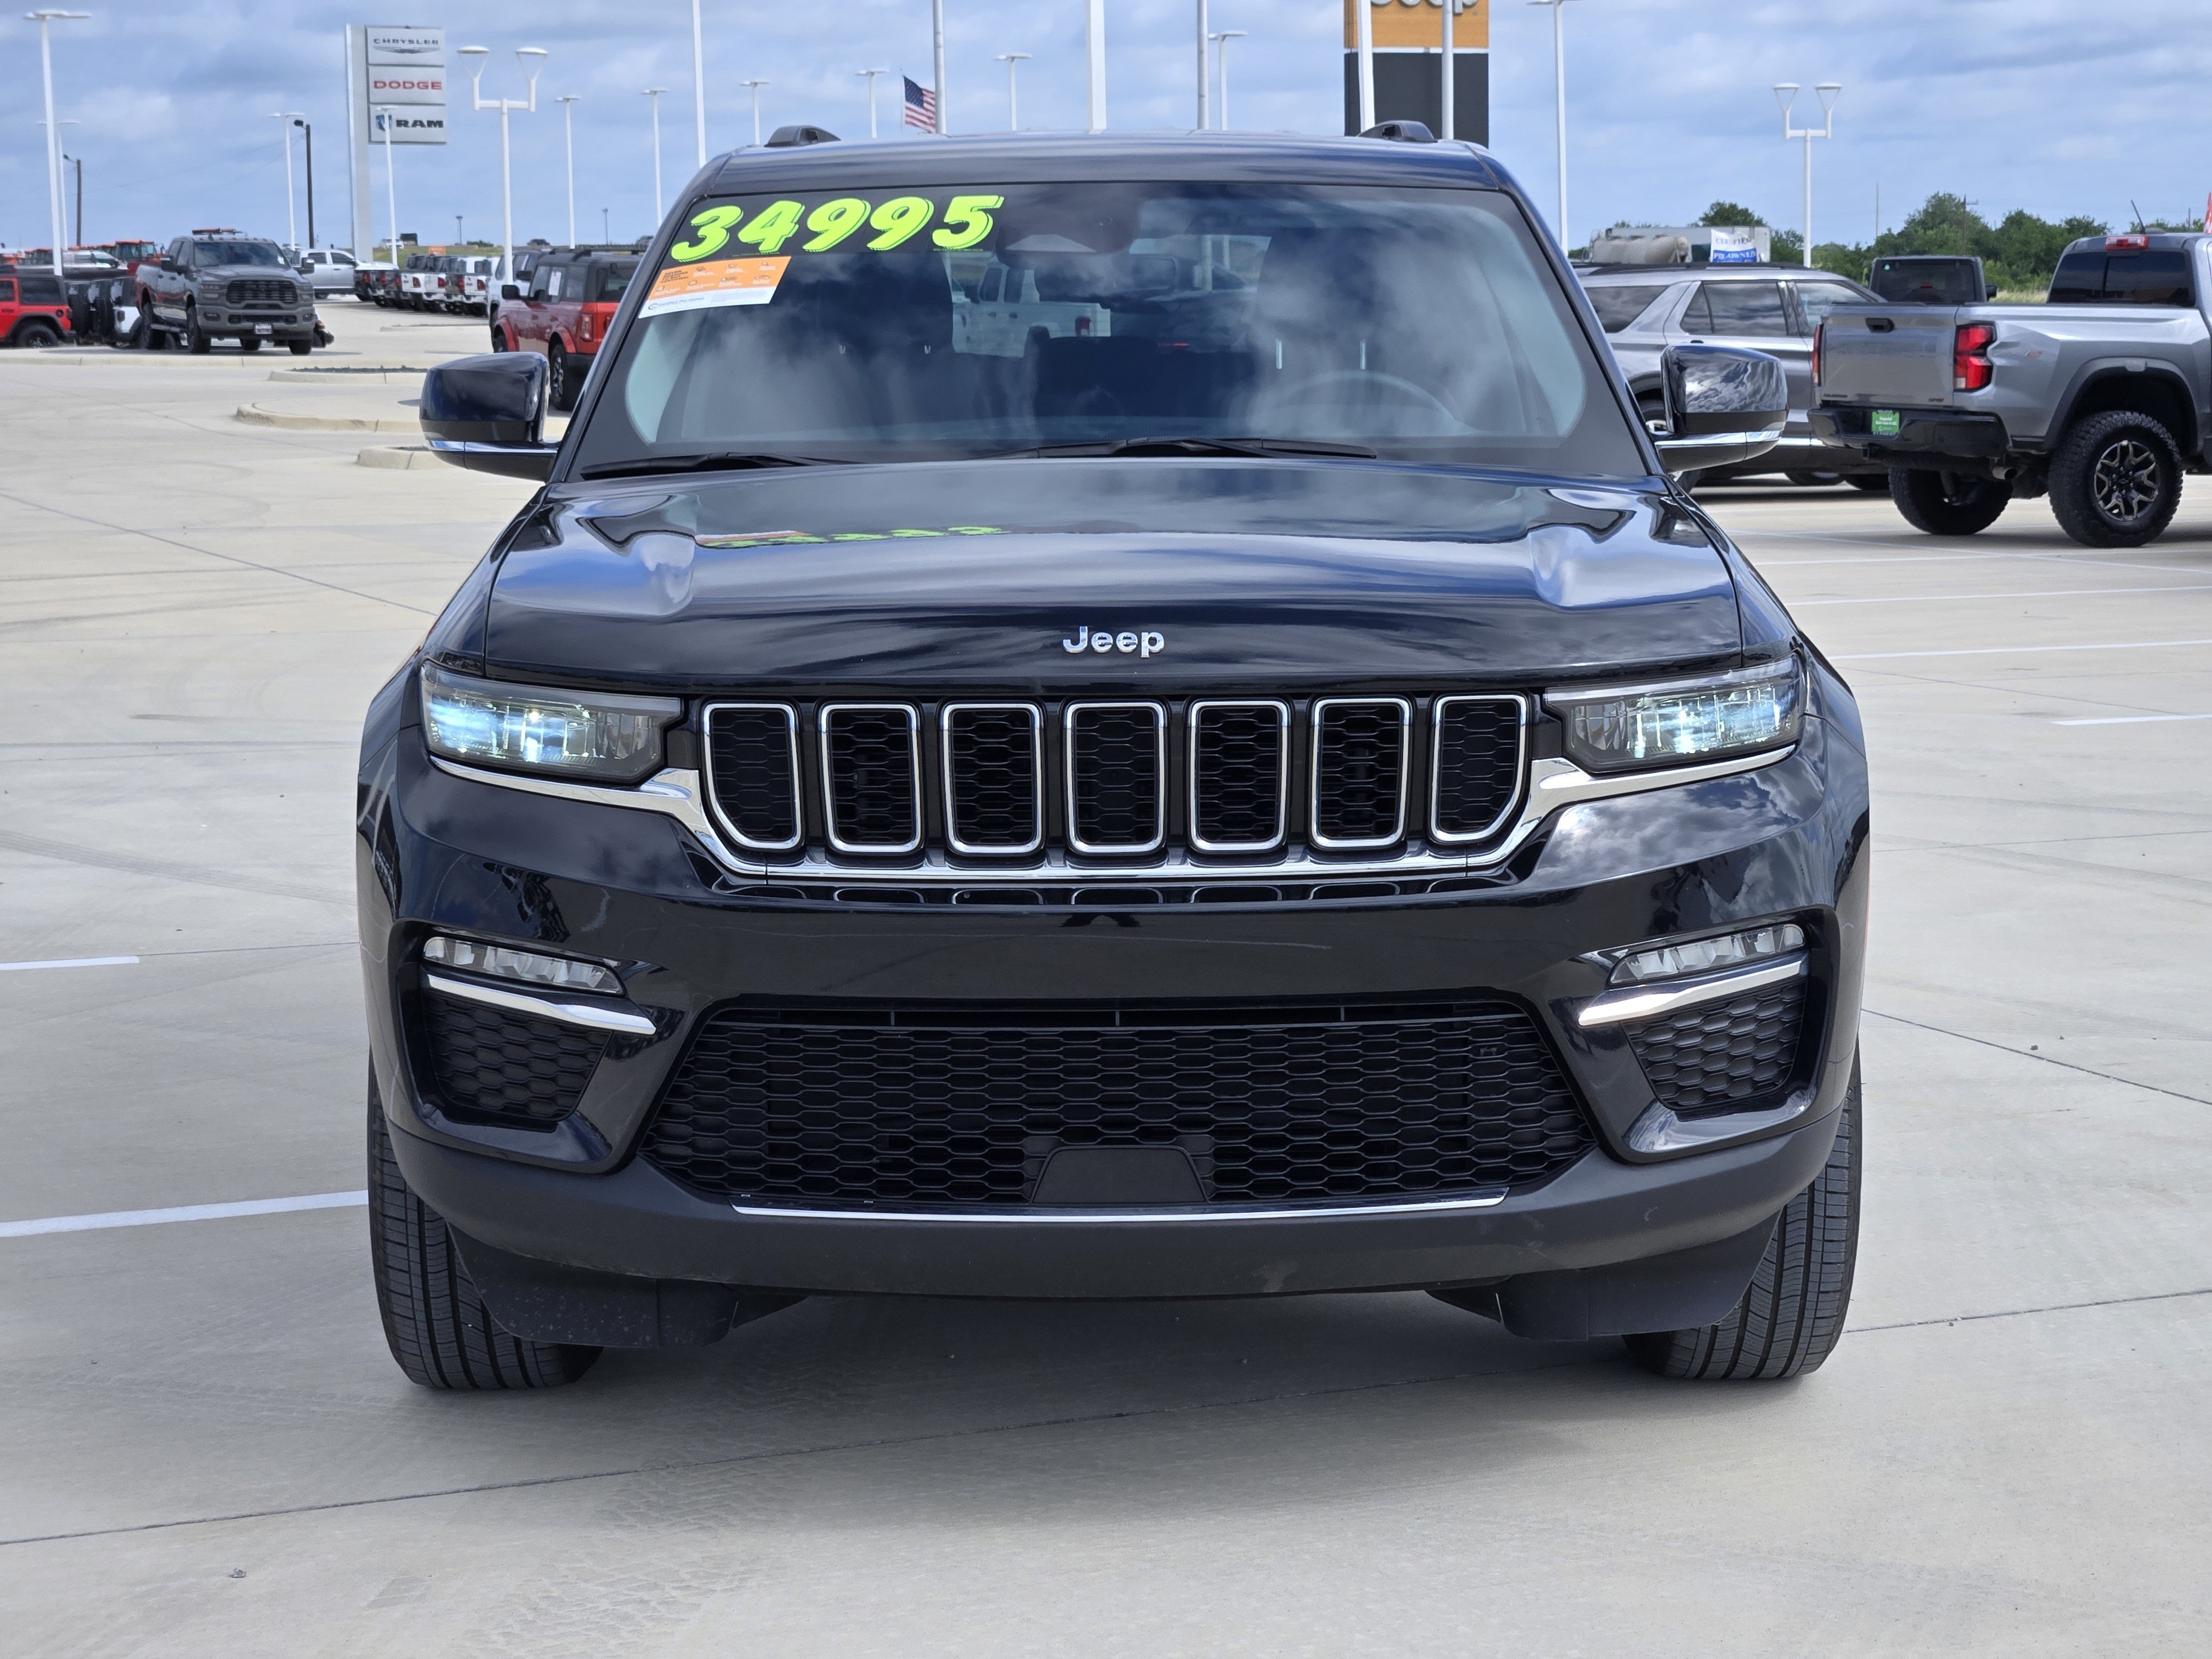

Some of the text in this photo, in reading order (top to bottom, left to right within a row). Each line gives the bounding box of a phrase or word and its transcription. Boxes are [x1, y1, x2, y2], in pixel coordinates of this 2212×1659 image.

[373, 80, 442, 90] DODGE
[395, 119, 444, 128] RAM
[671, 195, 1004, 263] 34995
[1062, 625, 1165, 658] Jeep
